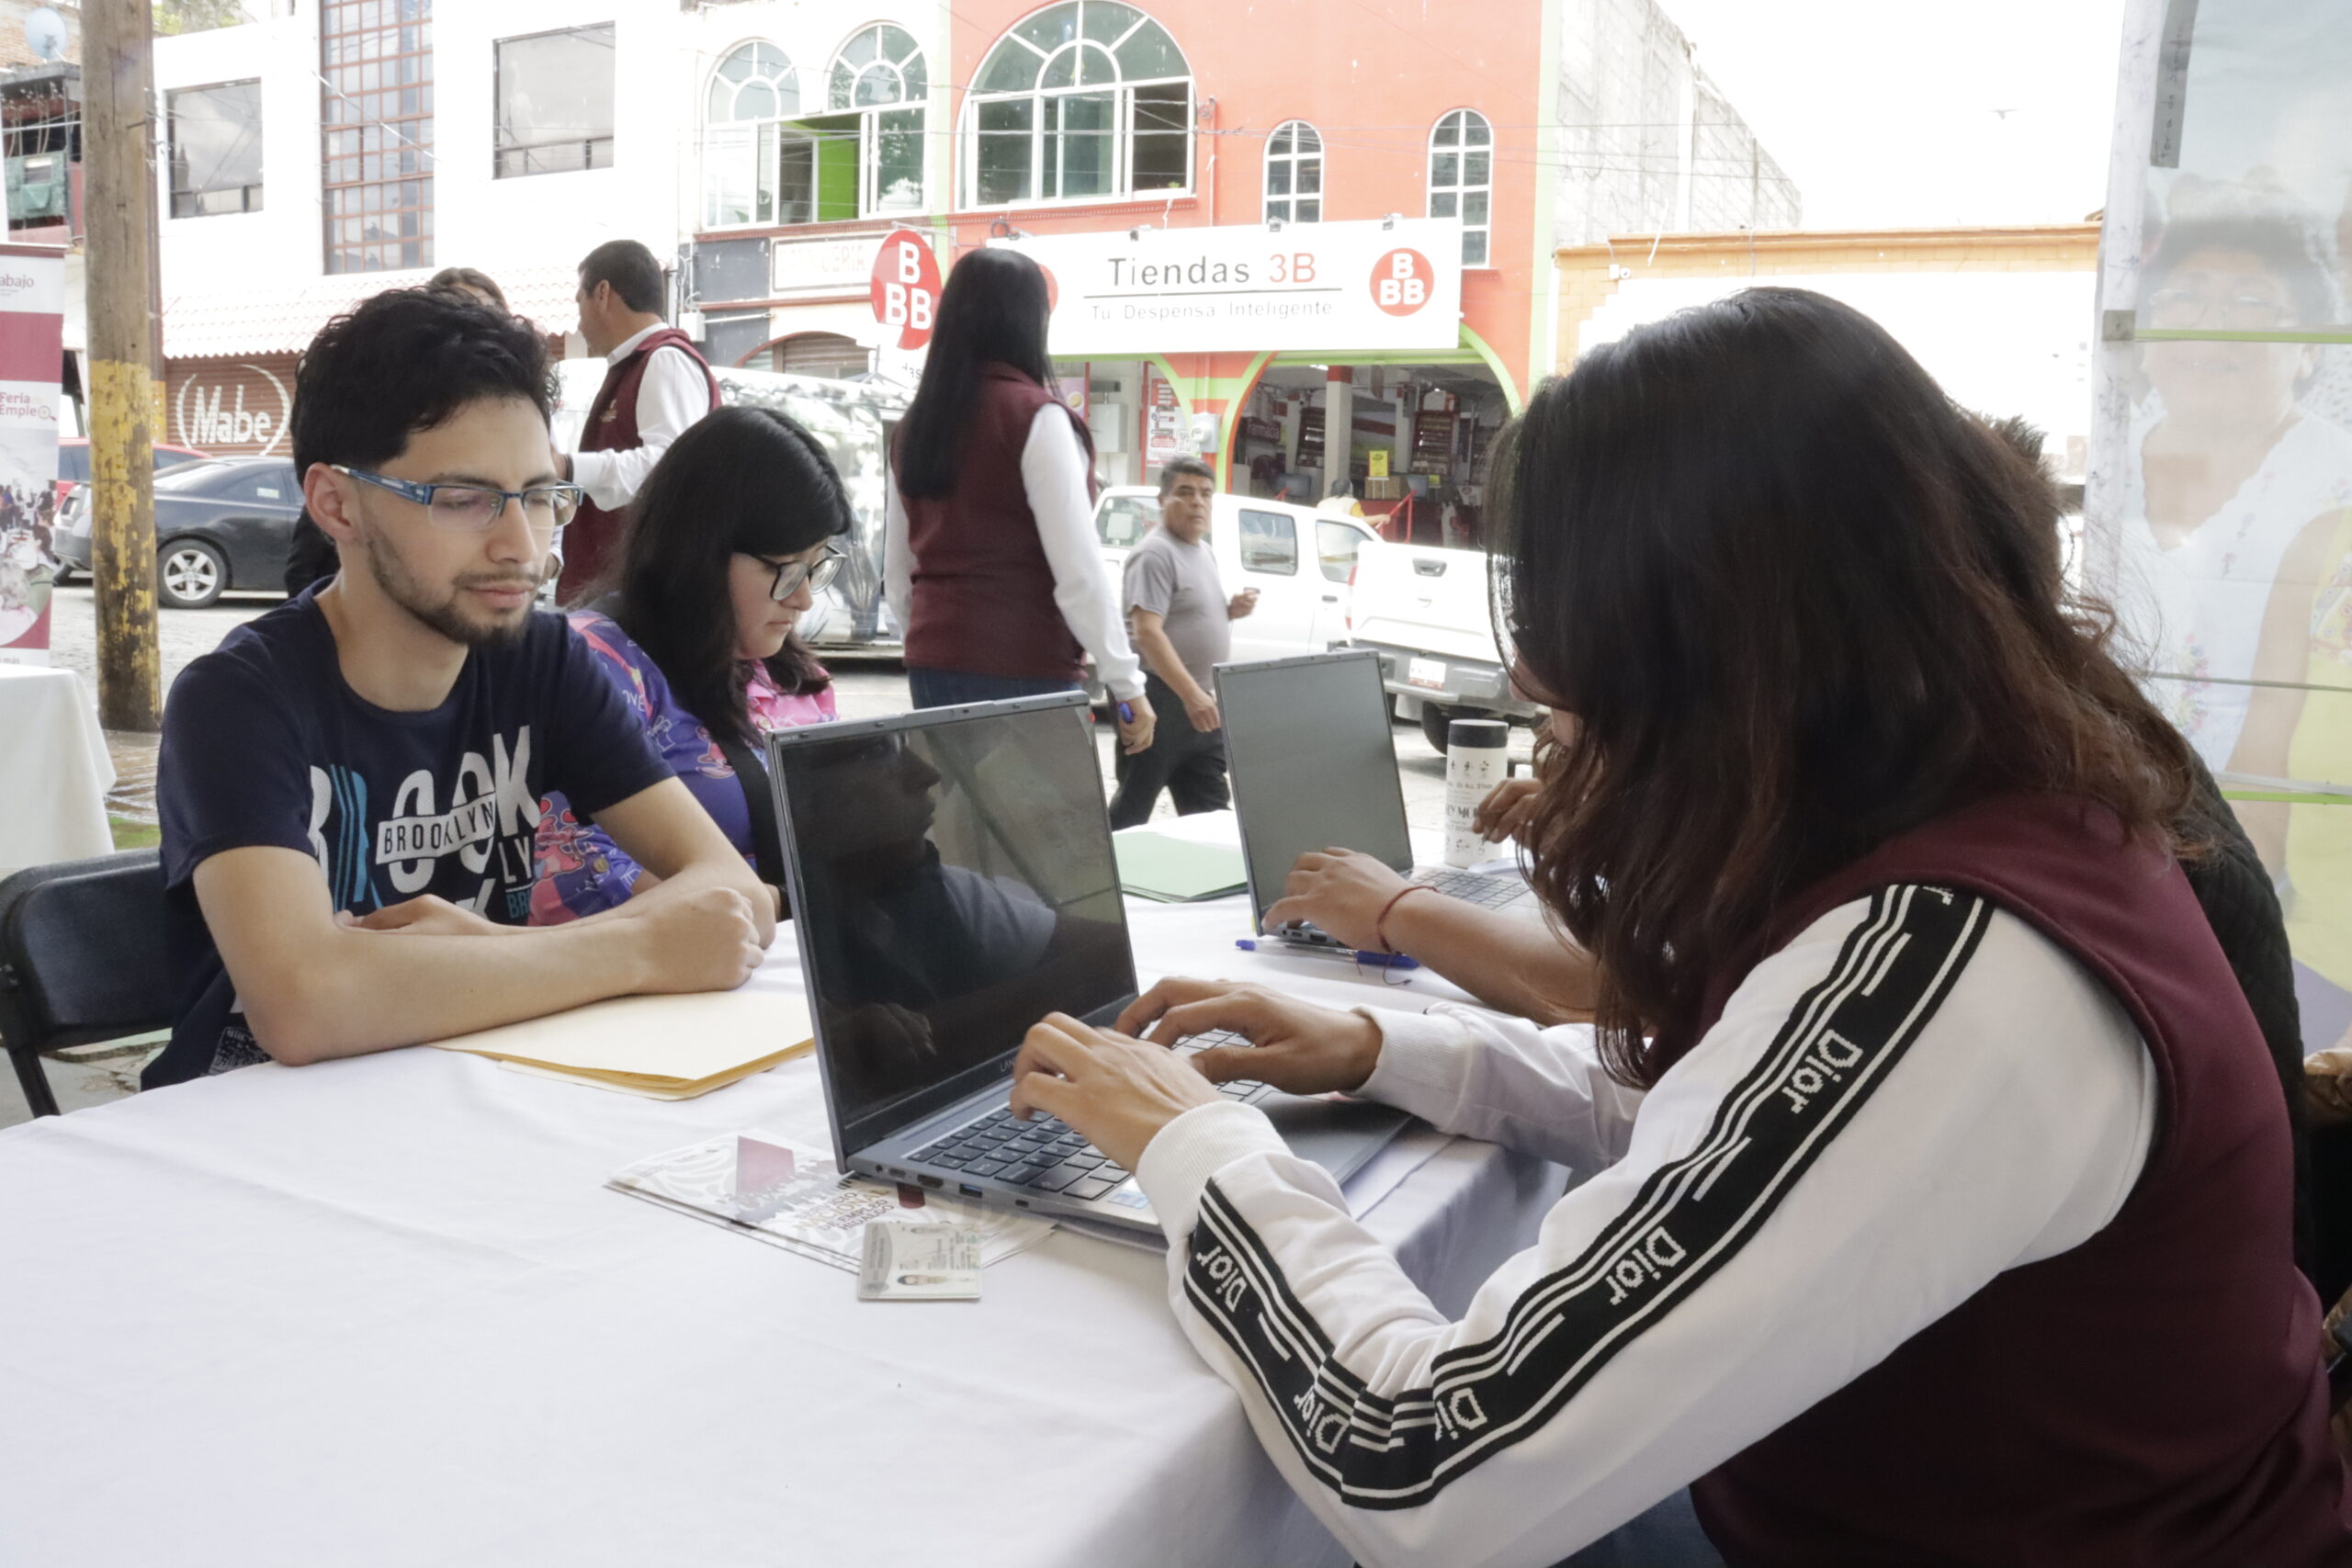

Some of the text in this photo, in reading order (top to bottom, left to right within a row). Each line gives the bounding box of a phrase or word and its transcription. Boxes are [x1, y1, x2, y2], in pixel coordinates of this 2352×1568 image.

[1107, 252, 1317, 287] Tiendas 3B
[1092, 299, 1333, 322] Tu Despensa Inteligente
[0, 391, 30, 404] Feria
[383, 800, 495, 855] BROOKLYN
[1781, 1028, 1864, 1114] Dior
[837, 1198, 888, 1224] EMPLEO
[837, 1203, 895, 1231] HIDALGO
[1195, 1245, 1249, 1313] Dior
[1605, 1225, 1688, 1306] Dior
[1433, 1386, 1488, 1442] Di
